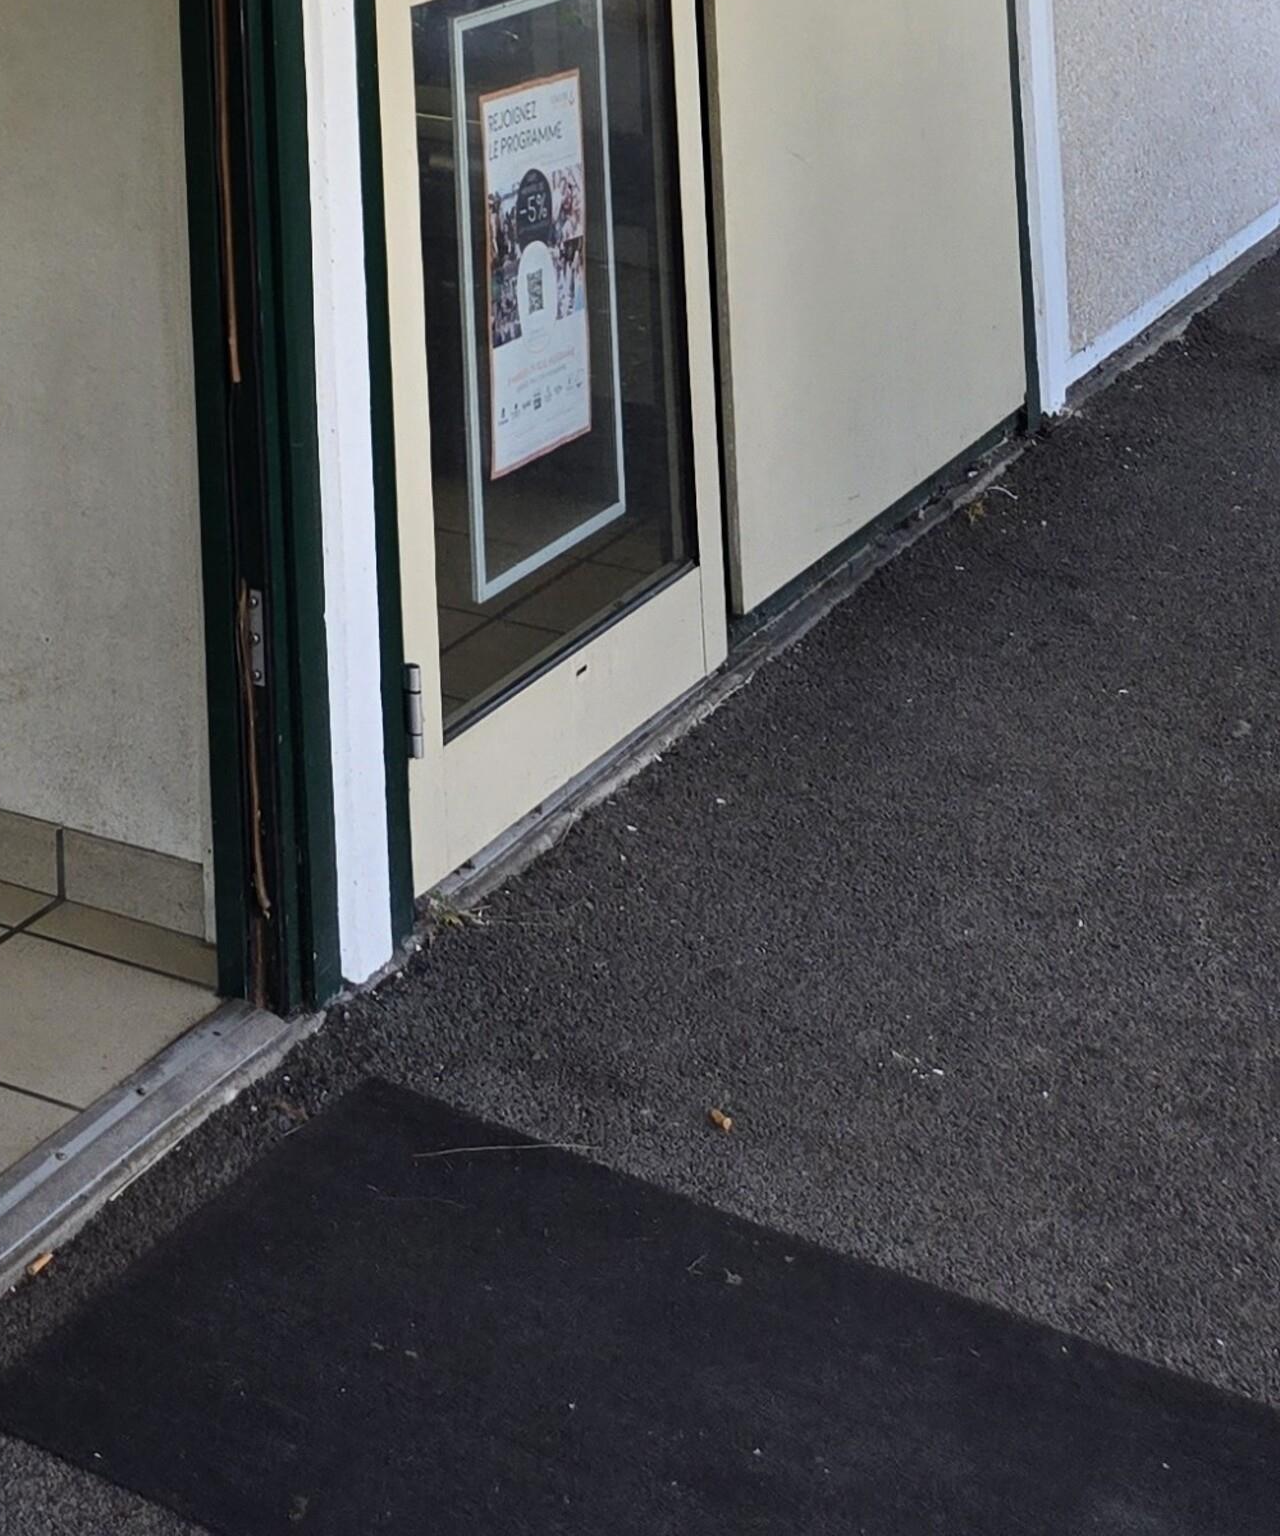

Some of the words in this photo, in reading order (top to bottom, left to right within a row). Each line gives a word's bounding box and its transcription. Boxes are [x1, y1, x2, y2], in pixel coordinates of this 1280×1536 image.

[488, 100, 537, 132] REJOIGNEZ
[500, 120, 563, 156] PROGRAMME
[520, 192, 547, 223] -5%
